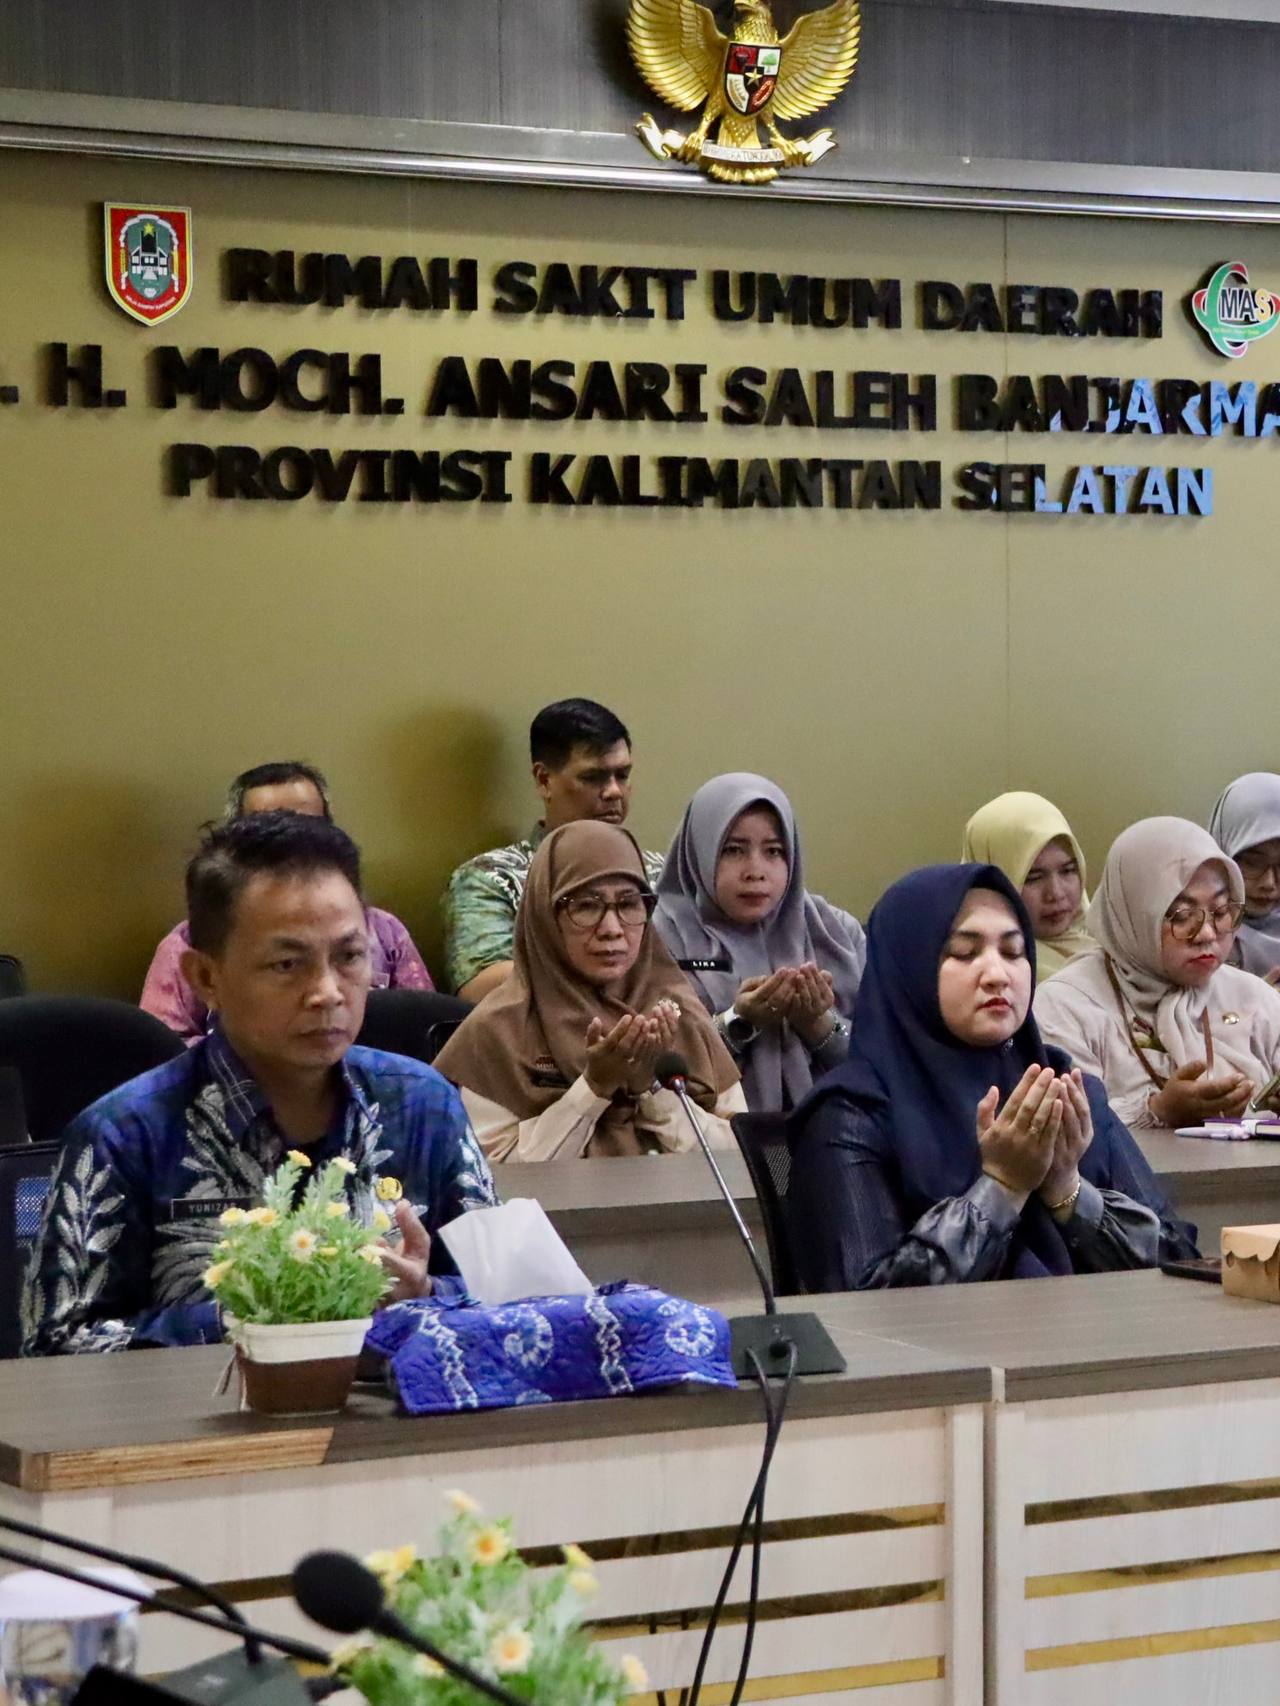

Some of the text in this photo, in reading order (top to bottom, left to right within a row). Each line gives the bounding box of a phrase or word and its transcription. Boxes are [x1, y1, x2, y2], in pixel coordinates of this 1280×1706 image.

[226, 247, 1163, 338] RUMAH SAKIT UMUM DAERAH
[1220, 287, 1271, 322] MAS
[47, 342, 126, 408] H.
[154, 346, 404, 416] MOCH.
[426, 356, 708, 423] ANSARI
[722, 366, 937, 432] SALEH
[168, 443, 1212, 516] PROVINSI KALIMANTAN SELATAN
